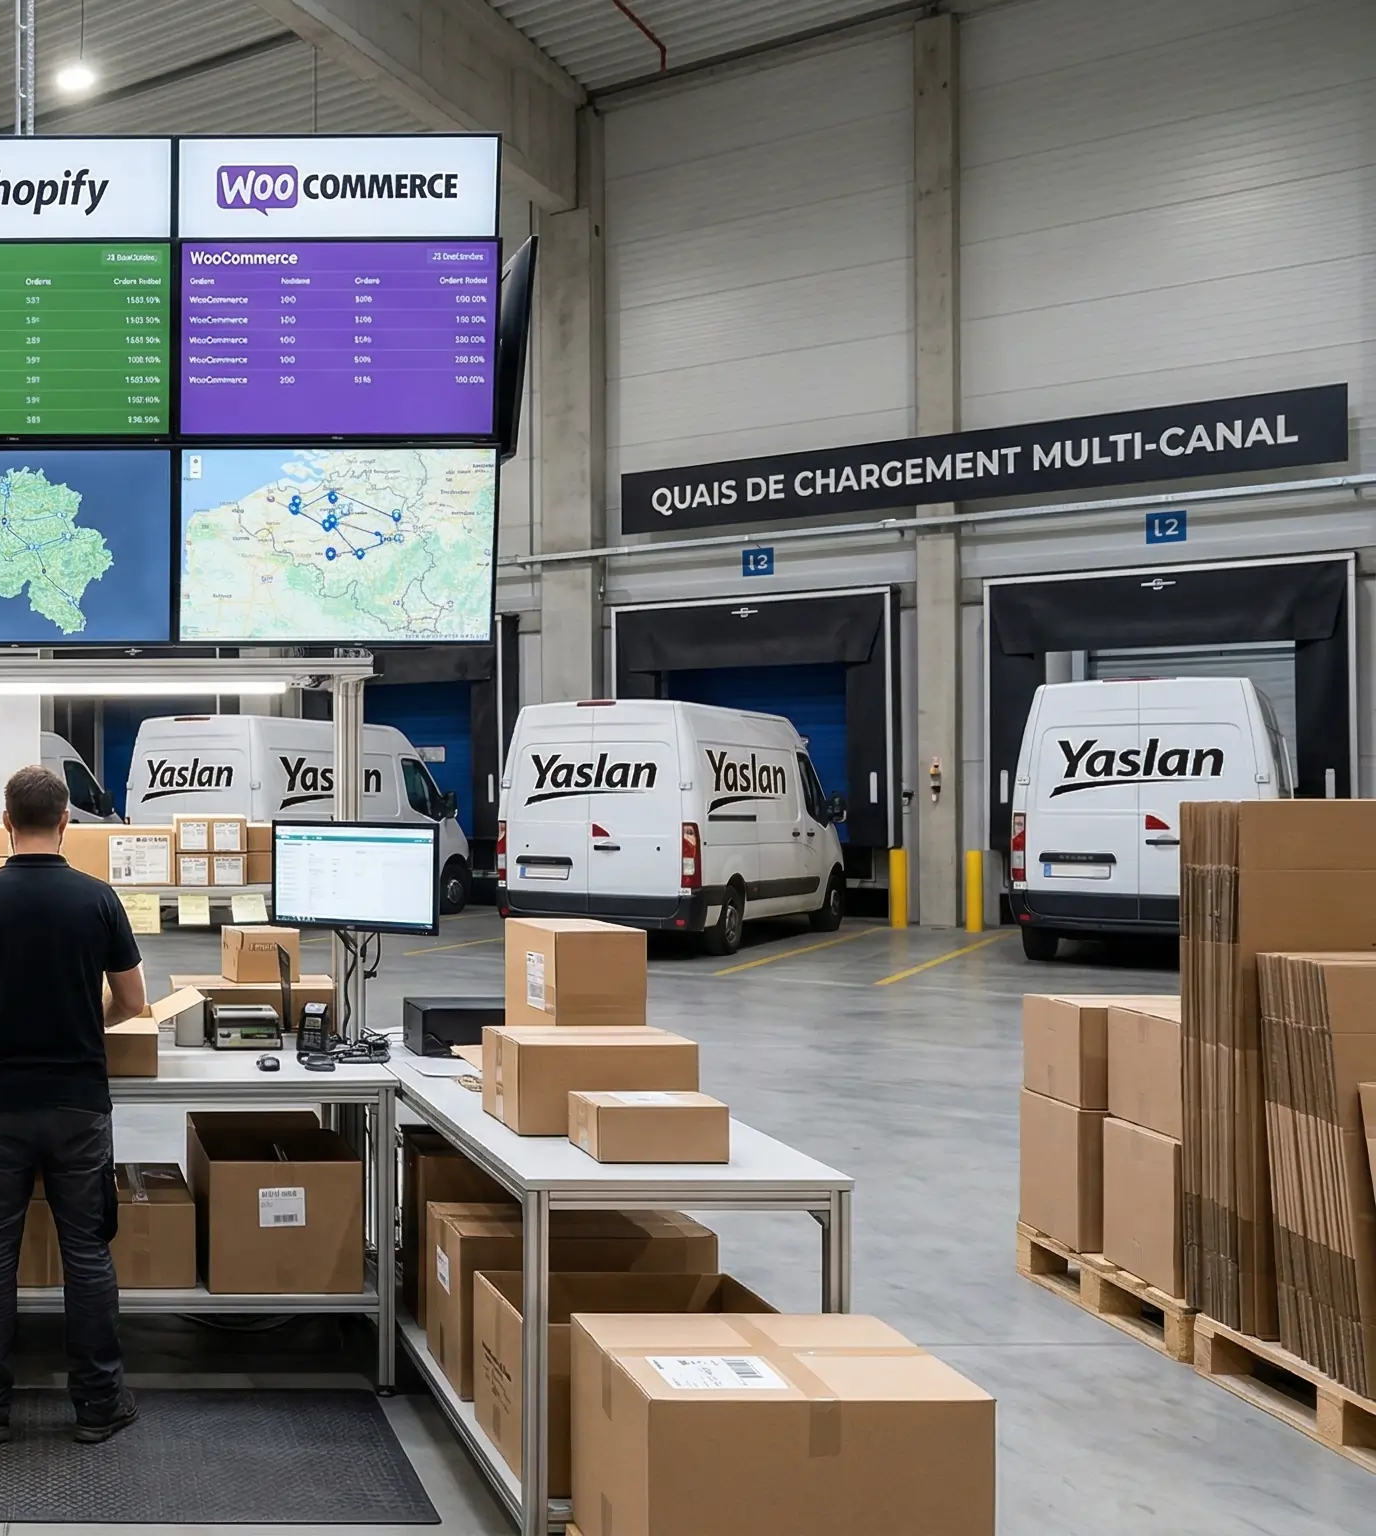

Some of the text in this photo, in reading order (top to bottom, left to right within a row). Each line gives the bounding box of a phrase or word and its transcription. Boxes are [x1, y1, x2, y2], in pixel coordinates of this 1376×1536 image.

[302, 173, 459, 200] COMMERCE
[190, 251, 298, 265] WooCommerce
[650, 413, 1299, 517] QUAIS DE CHARGEMENT MULTI-CANAL
[146, 757, 234, 789] Yaslan
[279, 756, 382, 793] Yasn
[530, 752, 658, 791] Yaslan
[704, 749, 787, 796] Yaslan
[1057, 737, 1226, 779] Yaslan
